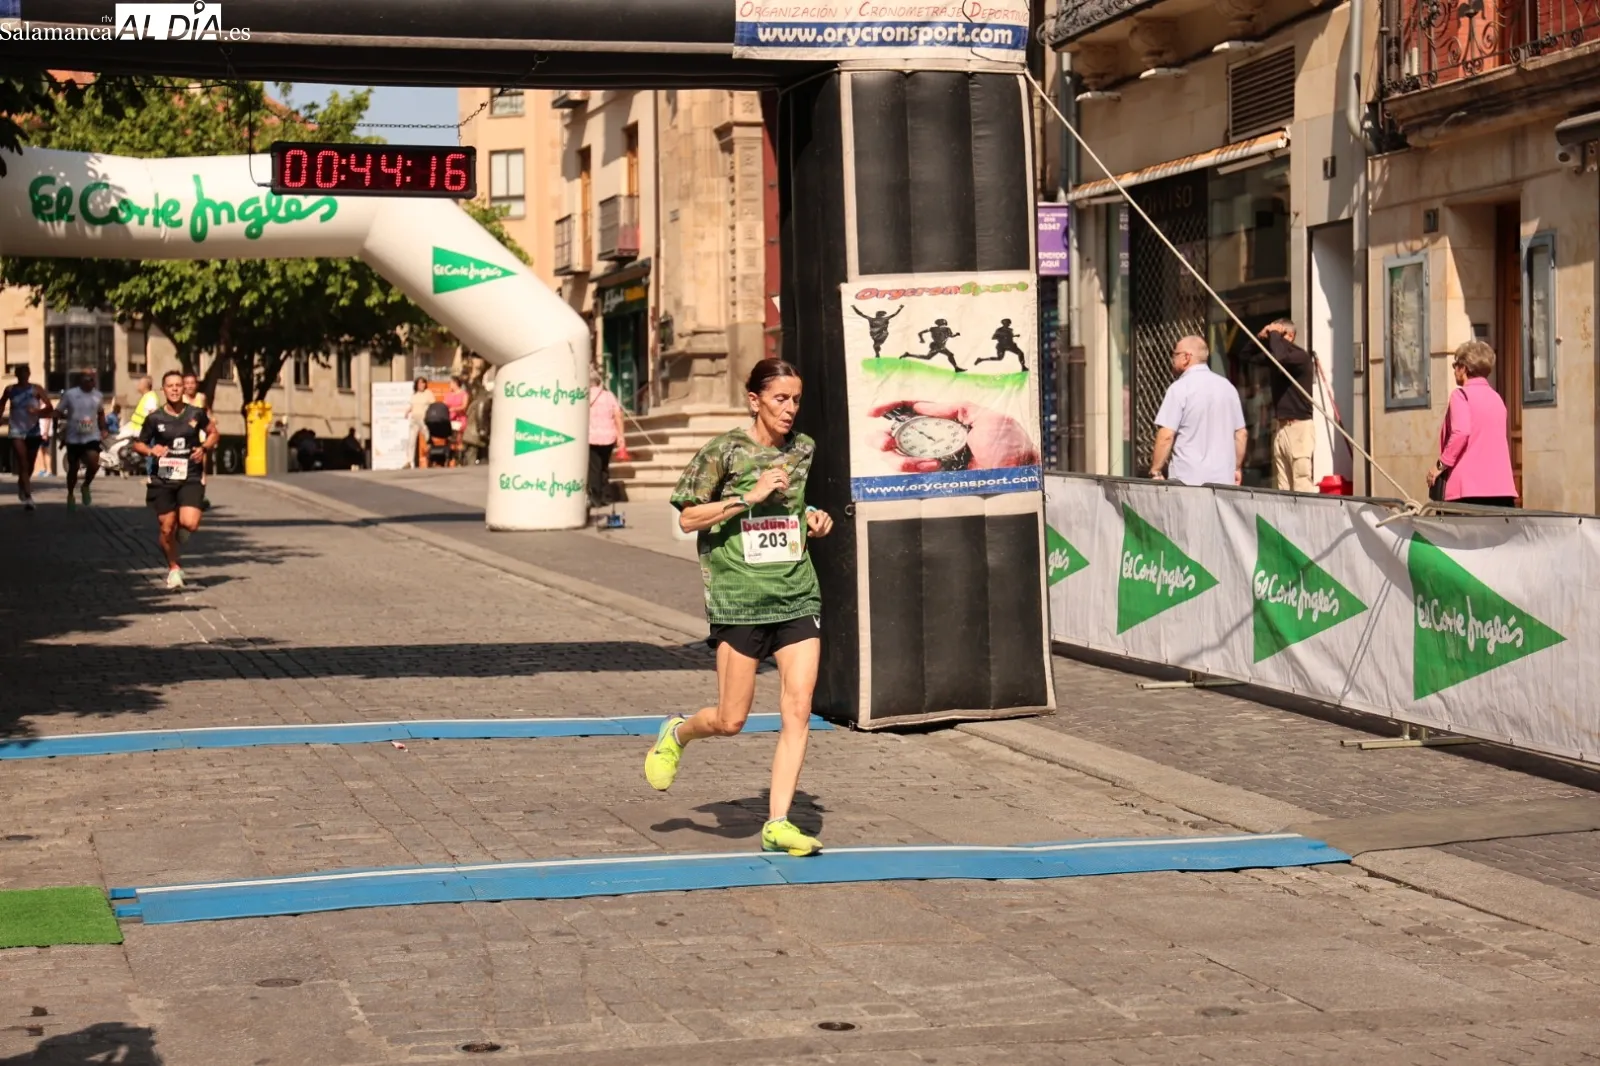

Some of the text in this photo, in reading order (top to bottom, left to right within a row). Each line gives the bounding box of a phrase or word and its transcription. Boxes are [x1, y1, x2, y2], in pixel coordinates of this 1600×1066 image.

[740, 2, 838, 19] ORGANIZACIÓN
[844, 6, 852, 19] Y
[859, 1, 963, 18] CRONOMETRAJE
[757, 22, 1013, 47] www.orycronsport.com
[284, 149, 466, 191] 00:44:16
[29, 175, 75, 223] El
[79, 182, 183, 229] Corte
[504, 381, 515, 397] El
[516, 382, 551, 398] Corte
[499, 473, 510, 490] El
[512, 474, 547, 491] Corte
[865, 475, 1040, 495] www.orycronsport.com
[758, 532, 788, 548] 203
[1048, 548, 1070, 577] glés
[1122, 550, 1196, 596] El Corte Inglés
[1254, 569, 1340, 623] El Corte Inglés
[1417, 594, 1524, 655] El Corte Inglés
